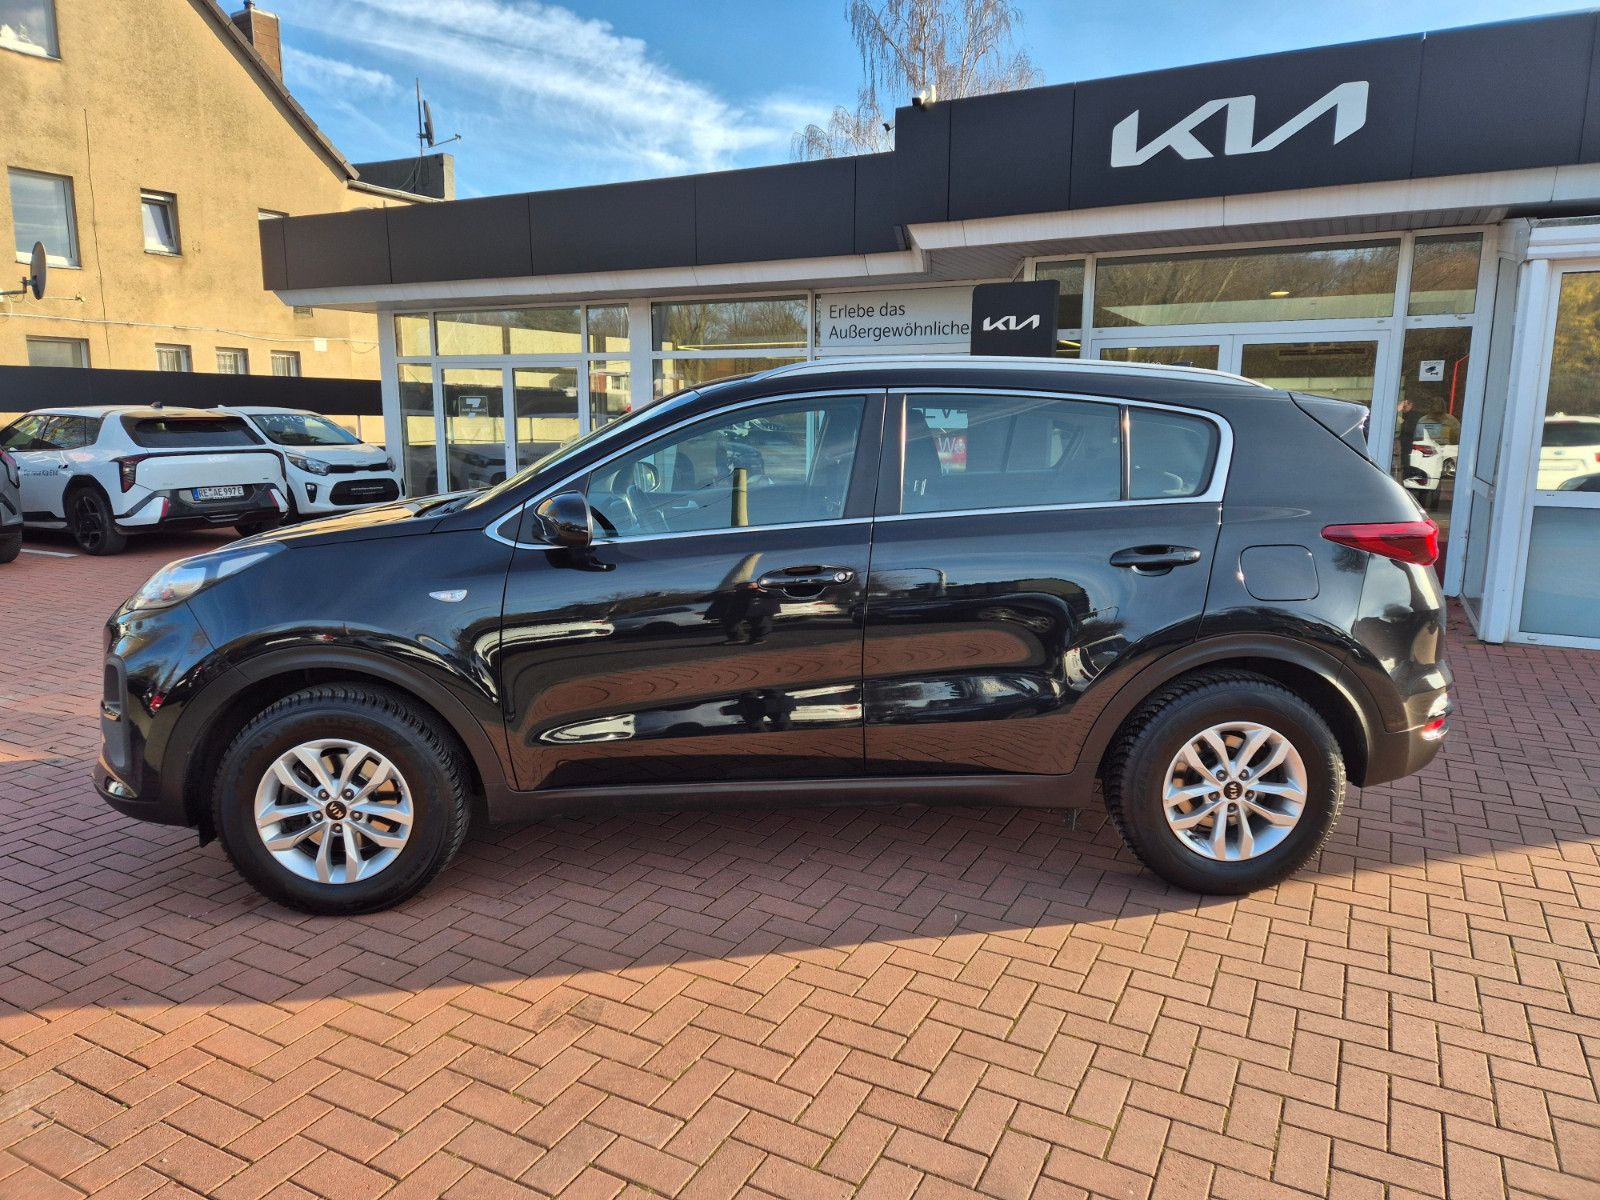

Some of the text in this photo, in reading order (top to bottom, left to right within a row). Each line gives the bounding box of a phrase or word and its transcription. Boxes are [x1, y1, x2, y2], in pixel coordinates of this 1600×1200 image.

[1110, 81, 1369, 168] KIA
[829, 302, 906, 319] Erlebe das
[829, 321, 970, 341] Außergewöhnliche
[983, 314, 1040, 331] KIA
